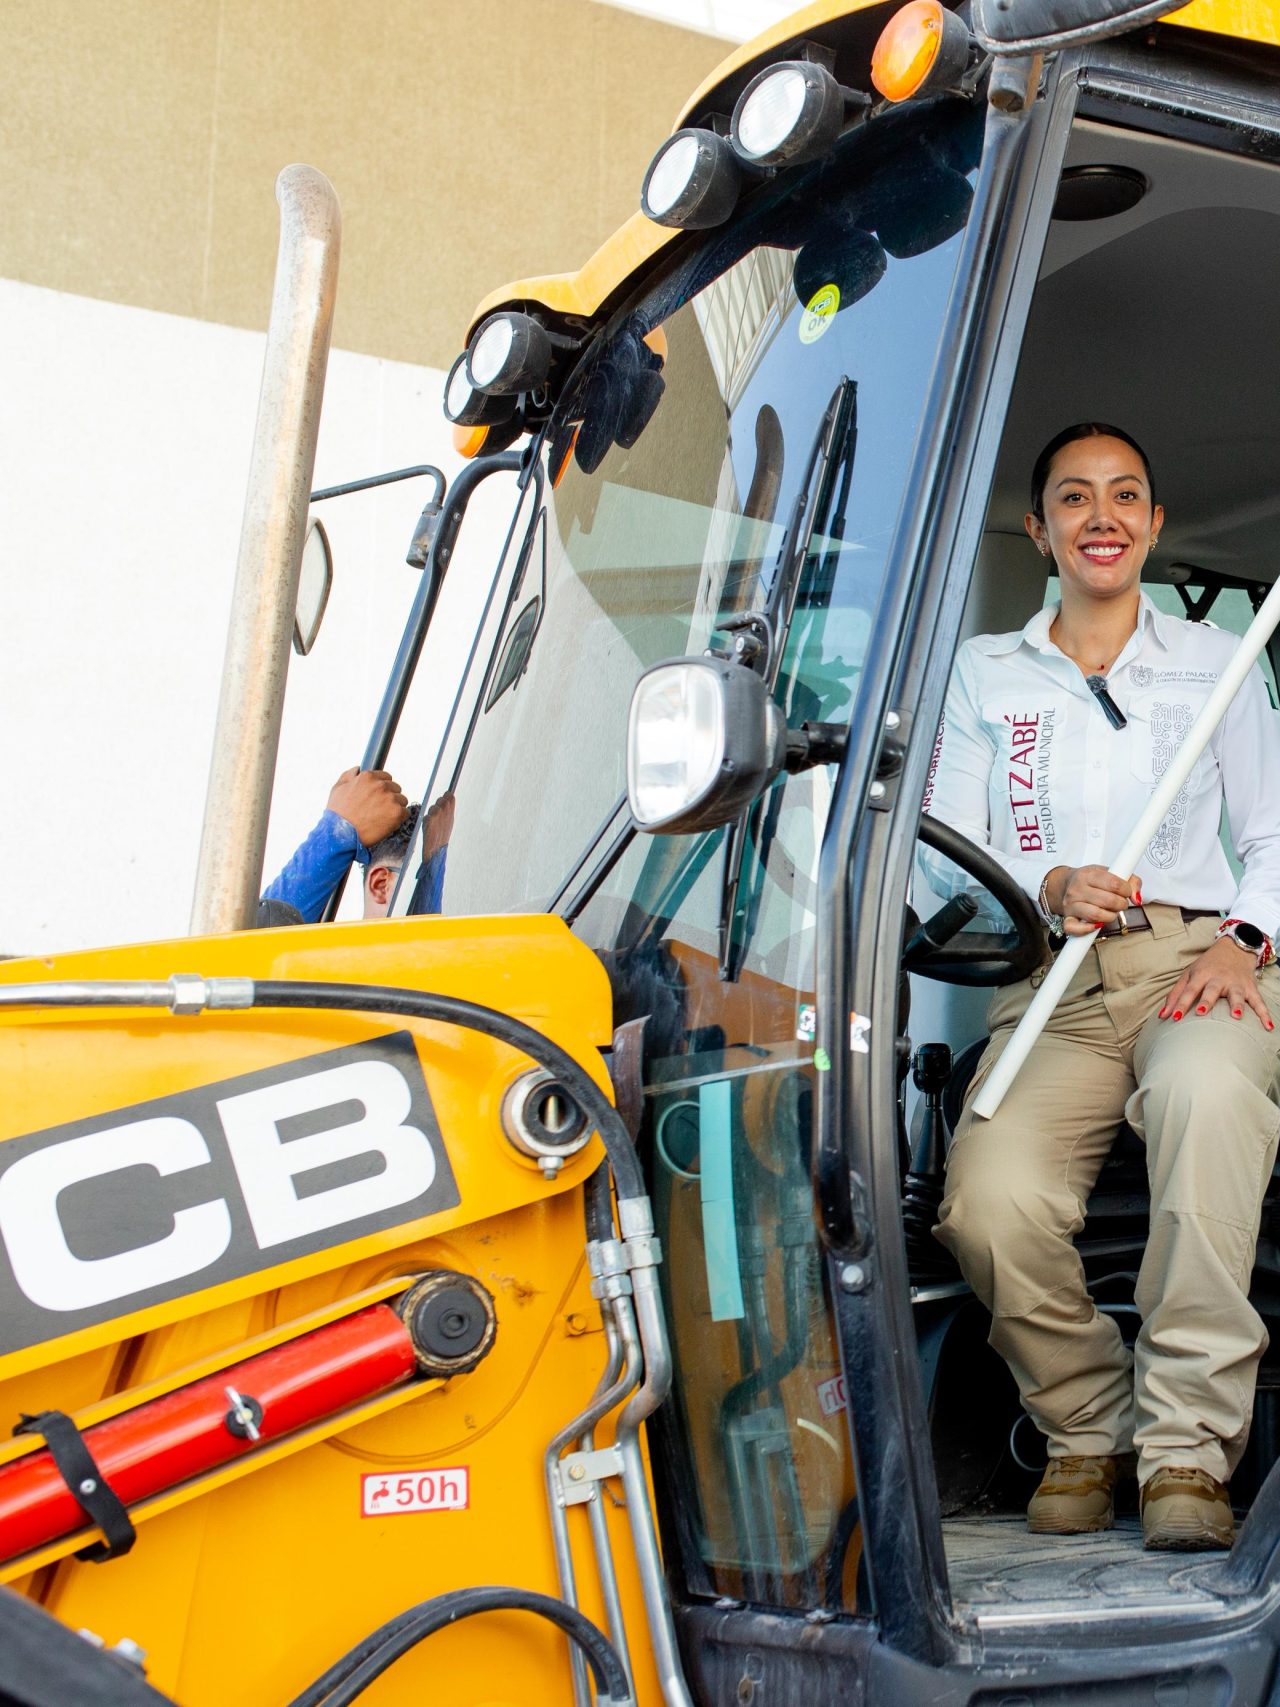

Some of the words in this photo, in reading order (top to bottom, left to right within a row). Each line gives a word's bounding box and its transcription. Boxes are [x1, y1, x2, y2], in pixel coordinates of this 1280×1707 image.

[808, 311, 827, 332] OK
[1185, 671, 1218, 679] PALACIO
[1036, 707, 1056, 772] MUNICIPAL
[1003, 713, 1043, 852] BETZABÉ
[1037, 774, 1057, 854] PRESIDENTA
[395, 1475, 459, 1506] 50h
